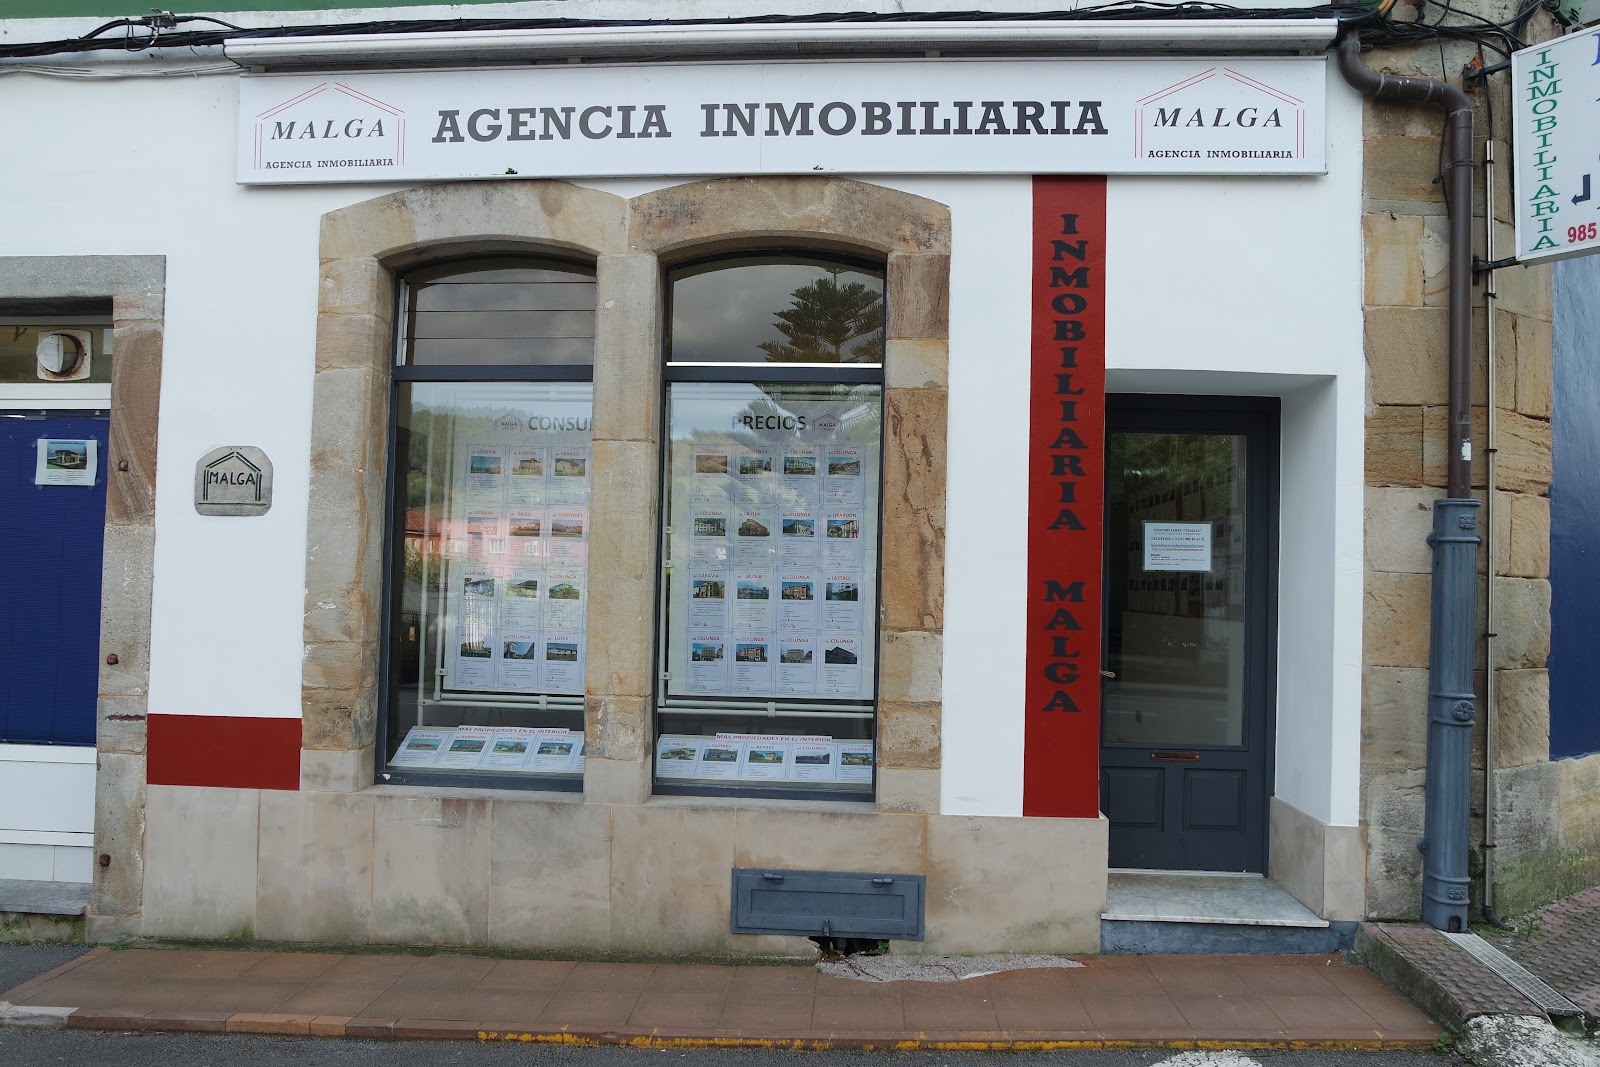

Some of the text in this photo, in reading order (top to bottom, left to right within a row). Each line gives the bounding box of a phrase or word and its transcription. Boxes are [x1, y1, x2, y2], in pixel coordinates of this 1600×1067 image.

[432, 100, 1109, 143] AGENCIA INMOBILIARIA
[1153, 107, 1283, 128] MALGA
[271, 119, 386, 140] MALGA
[1147, 150, 1293, 159] AGENCIA INMOBILIARIA
[1526, 49, 1562, 251] INMOBILIARIA
[265, 158, 394, 169] AGENCIA INMOBILIARIA
[1567, 222, 1597, 244] 985
[731, 415, 806, 431] PRECIOS
[1041, 213, 1090, 713] INMOBILIARIA MALGA
[208, 471, 256, 486] MALGA
